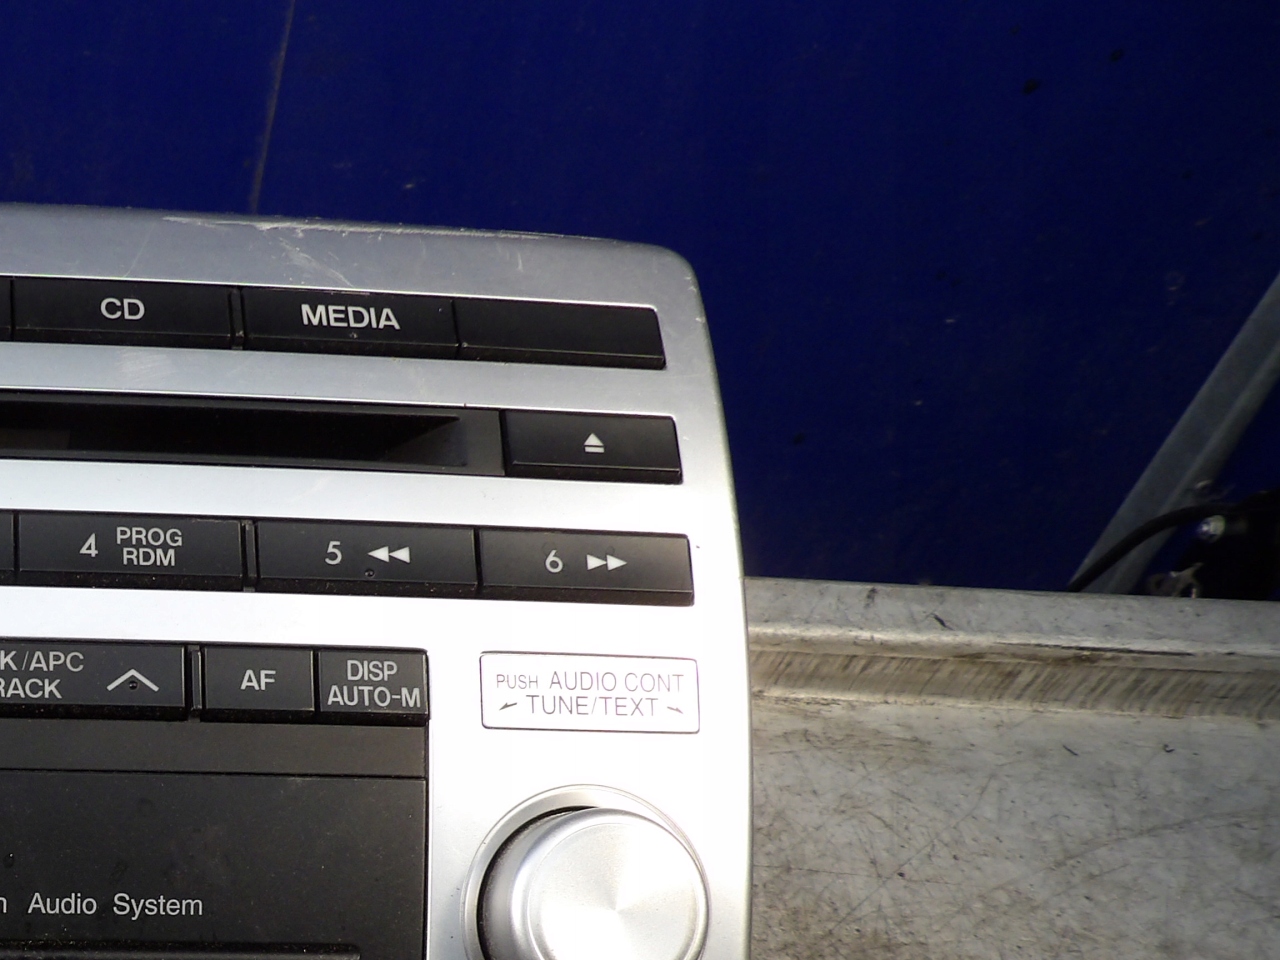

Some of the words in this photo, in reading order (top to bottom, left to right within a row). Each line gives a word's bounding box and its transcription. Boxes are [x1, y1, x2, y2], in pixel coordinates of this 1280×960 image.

[100, 297, 145, 320] CD
[301, 303, 401, 330] MEDIA
[79, 533, 99, 558] 4
[116, 526, 183, 547] PROG
[122, 547, 175, 567] RDM
[324, 540, 343, 565] 5
[545, 549, 564, 573] 6
[240, 669, 277, 691] AF
[346, 659, 398, 682] DISP
[496, 674, 539, 689] PUSH
[549, 671, 617, 691] AUDIO
[624, 672, 684, 692] CONT
[327, 684, 421, 708] AUTO-M
[526, 694, 659, 716] TUNE/TEXT
[27, 892, 97, 915] Audio
[113, 892, 203, 921] System
